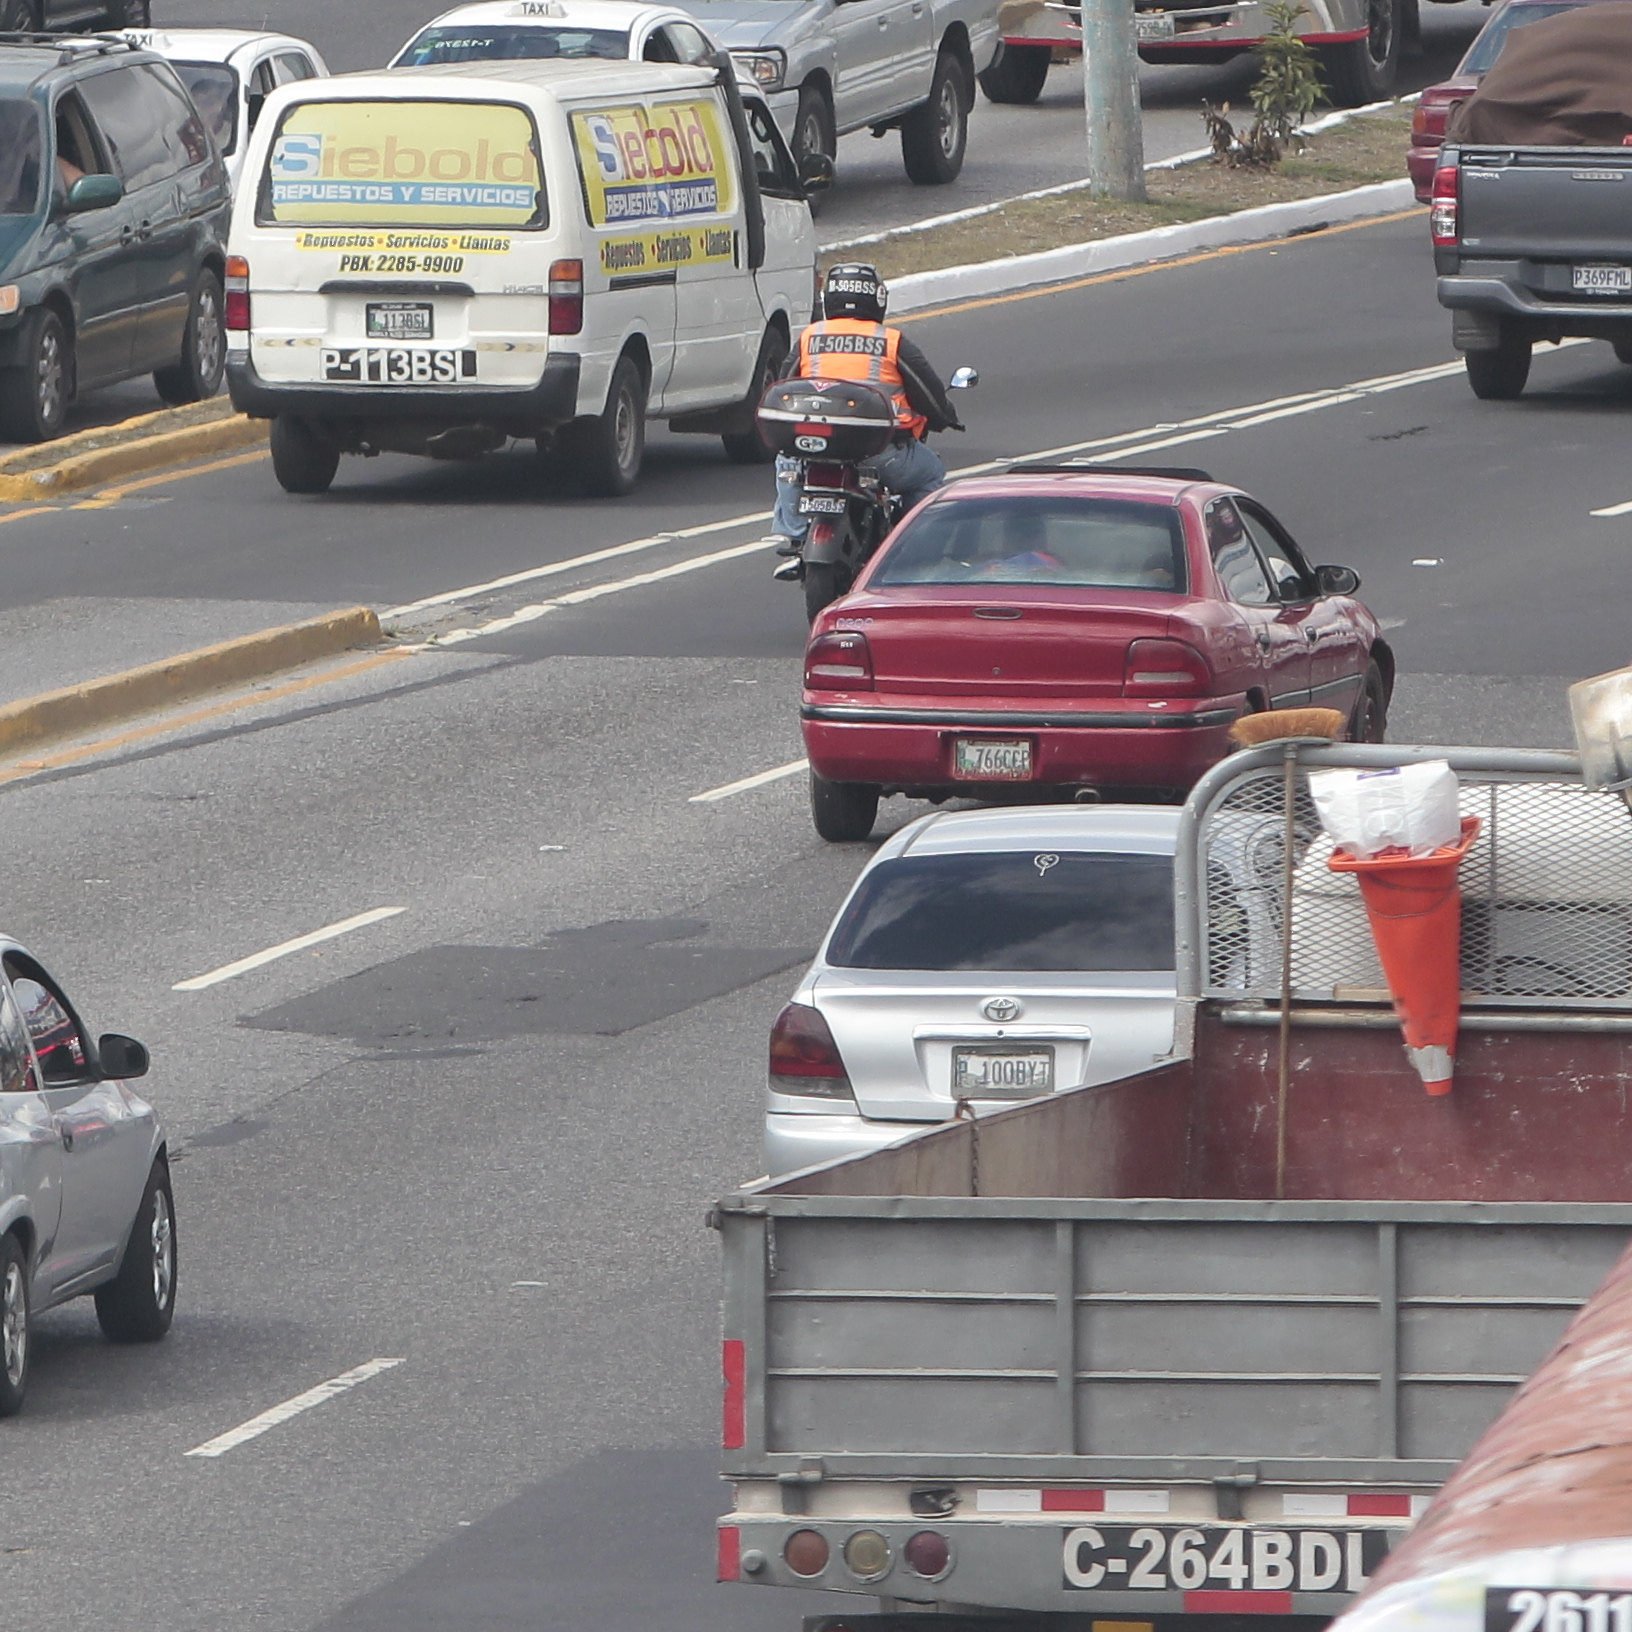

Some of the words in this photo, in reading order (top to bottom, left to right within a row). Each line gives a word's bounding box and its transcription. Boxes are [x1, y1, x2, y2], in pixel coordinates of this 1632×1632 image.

[521, 2, 549, 16] TAXI
[124, 33, 153, 46] TAXI
[584, 106, 714, 182] Siebold
[271, 135, 535, 181] Siebold
[272, 184, 392, 202] REPUESTOS
[399, 187, 415, 201] Y
[421, 187, 532, 206] SERVICIOS
[606, 190, 658, 218] REPUESTOS
[303, 234, 375, 249] Repuestos
[386, 234, 449, 249] Servicios
[459, 236, 511, 251] Llantas
[339, 254, 373, 272] PBX:
[375, 254, 464, 272] 2285-9900
[828, 279, 876, 294] M-505BSS
[809, 335, 885, 355] M-505BSS
[321, 348, 478, 382] P-113BSL
[1063, 1528, 1373, 1593] C-264BDL
